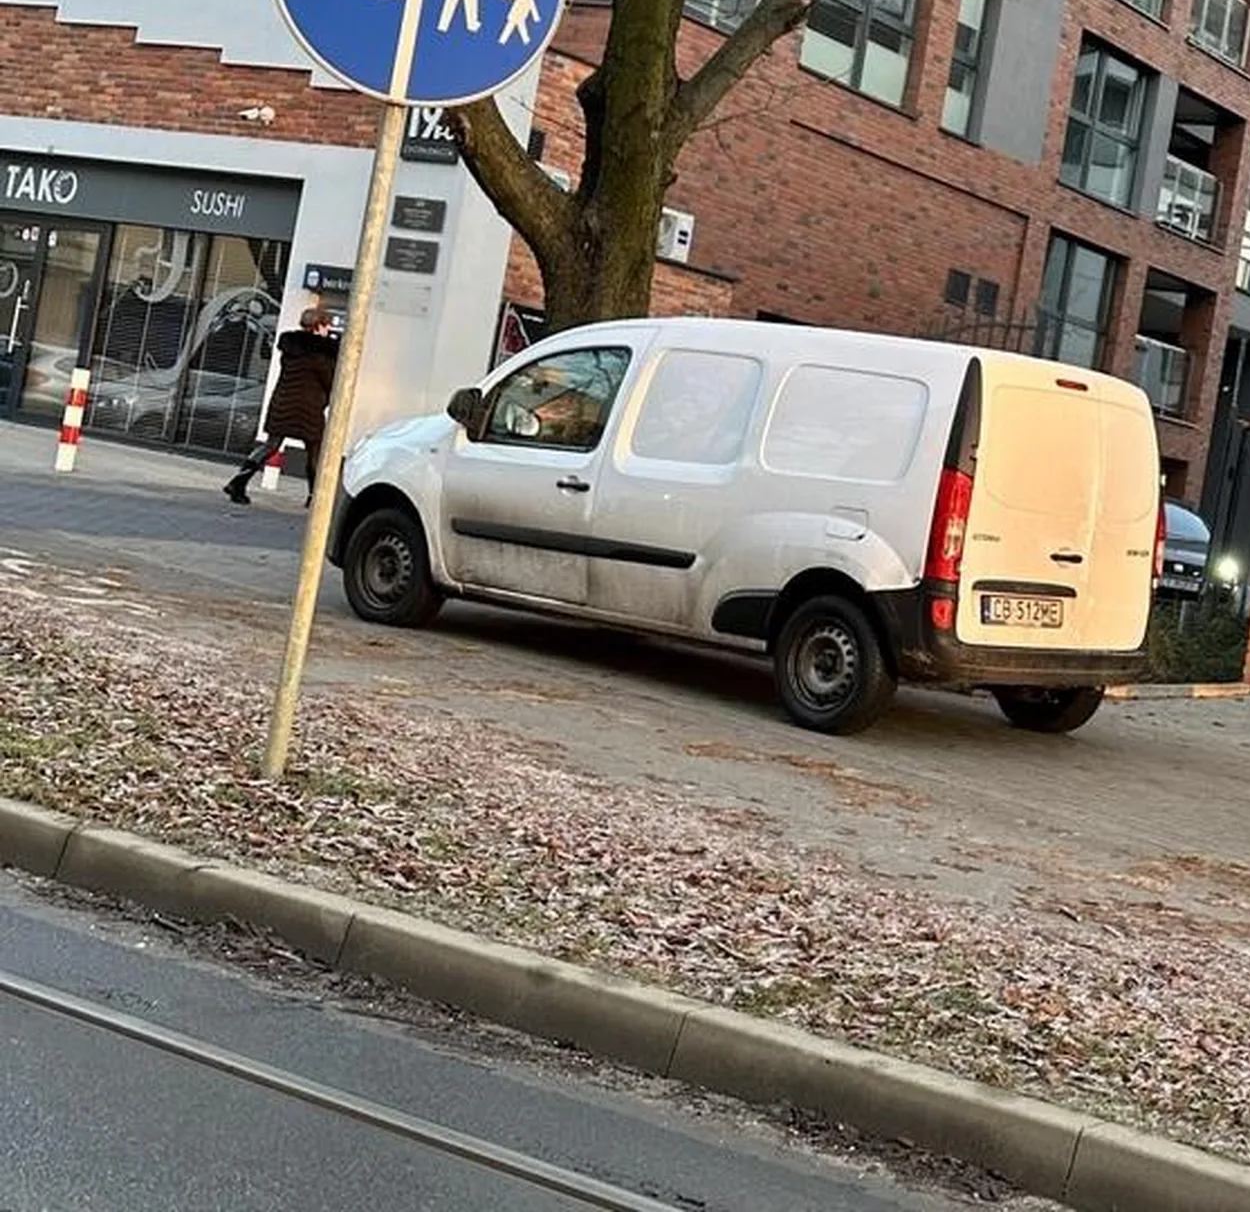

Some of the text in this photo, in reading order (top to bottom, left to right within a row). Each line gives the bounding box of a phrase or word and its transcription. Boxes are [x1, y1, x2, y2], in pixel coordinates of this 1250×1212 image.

[5, 165, 78, 204] TAKO
[190, 190, 246, 218] SUSHI
[993, 598, 1012, 620] CB
